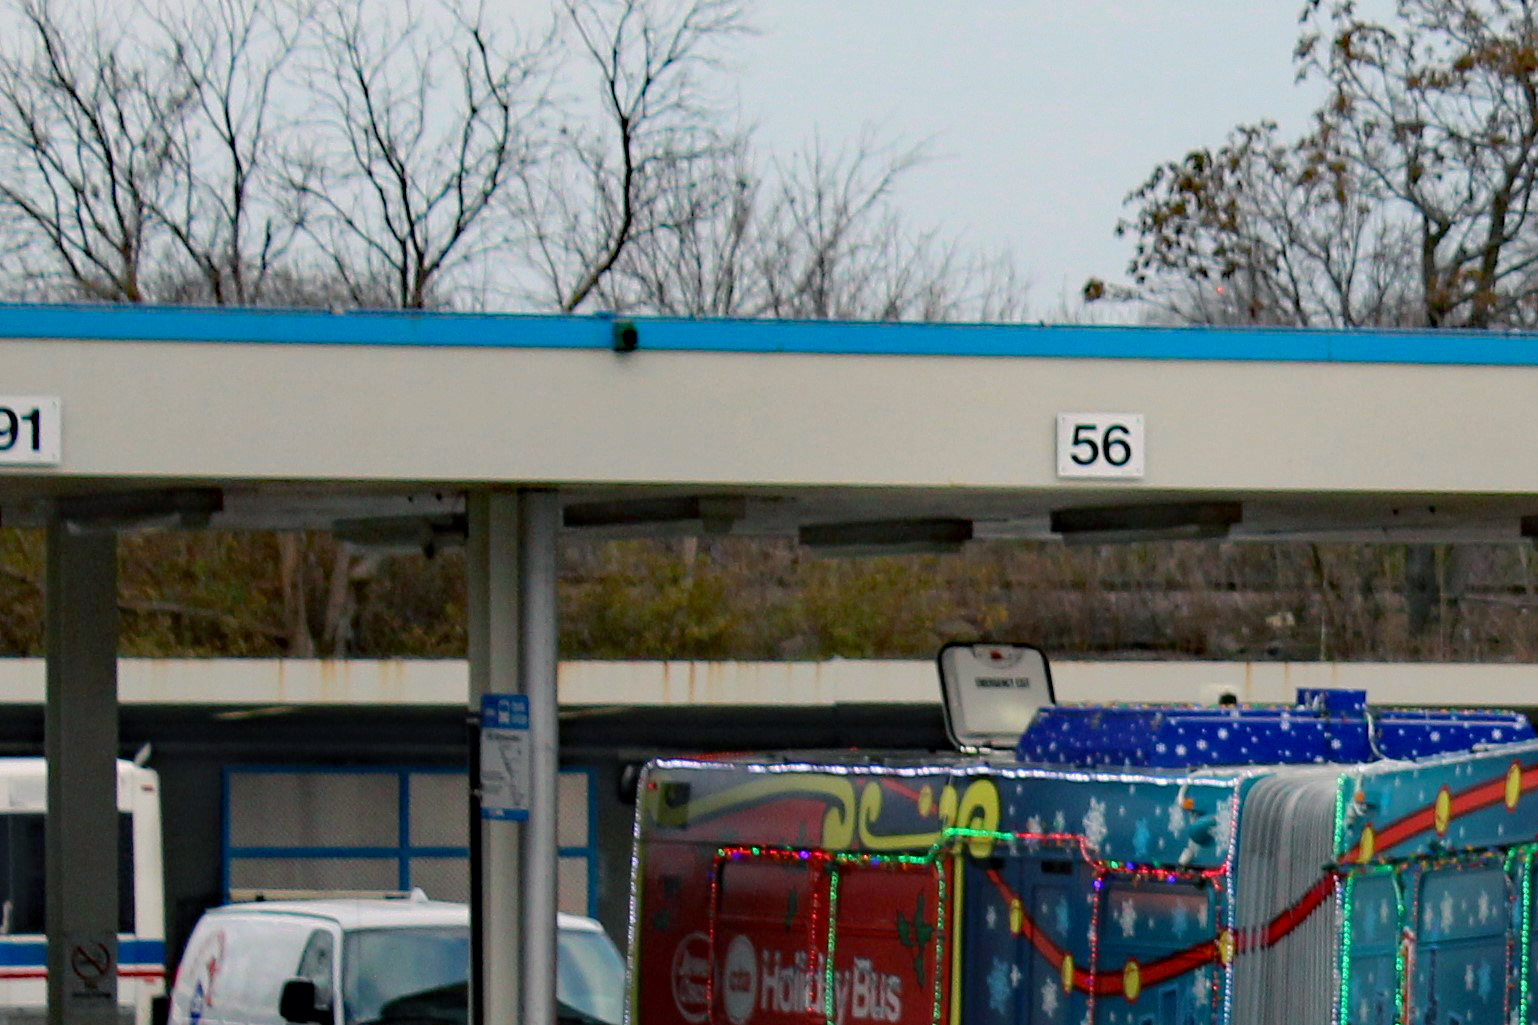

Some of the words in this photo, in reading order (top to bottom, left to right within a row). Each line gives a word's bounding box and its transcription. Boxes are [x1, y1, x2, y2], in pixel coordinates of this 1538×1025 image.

[0, 407, 40, 451] 91
[1071, 424, 1131, 467] 56
[852, 956, 901, 1023] Bus
